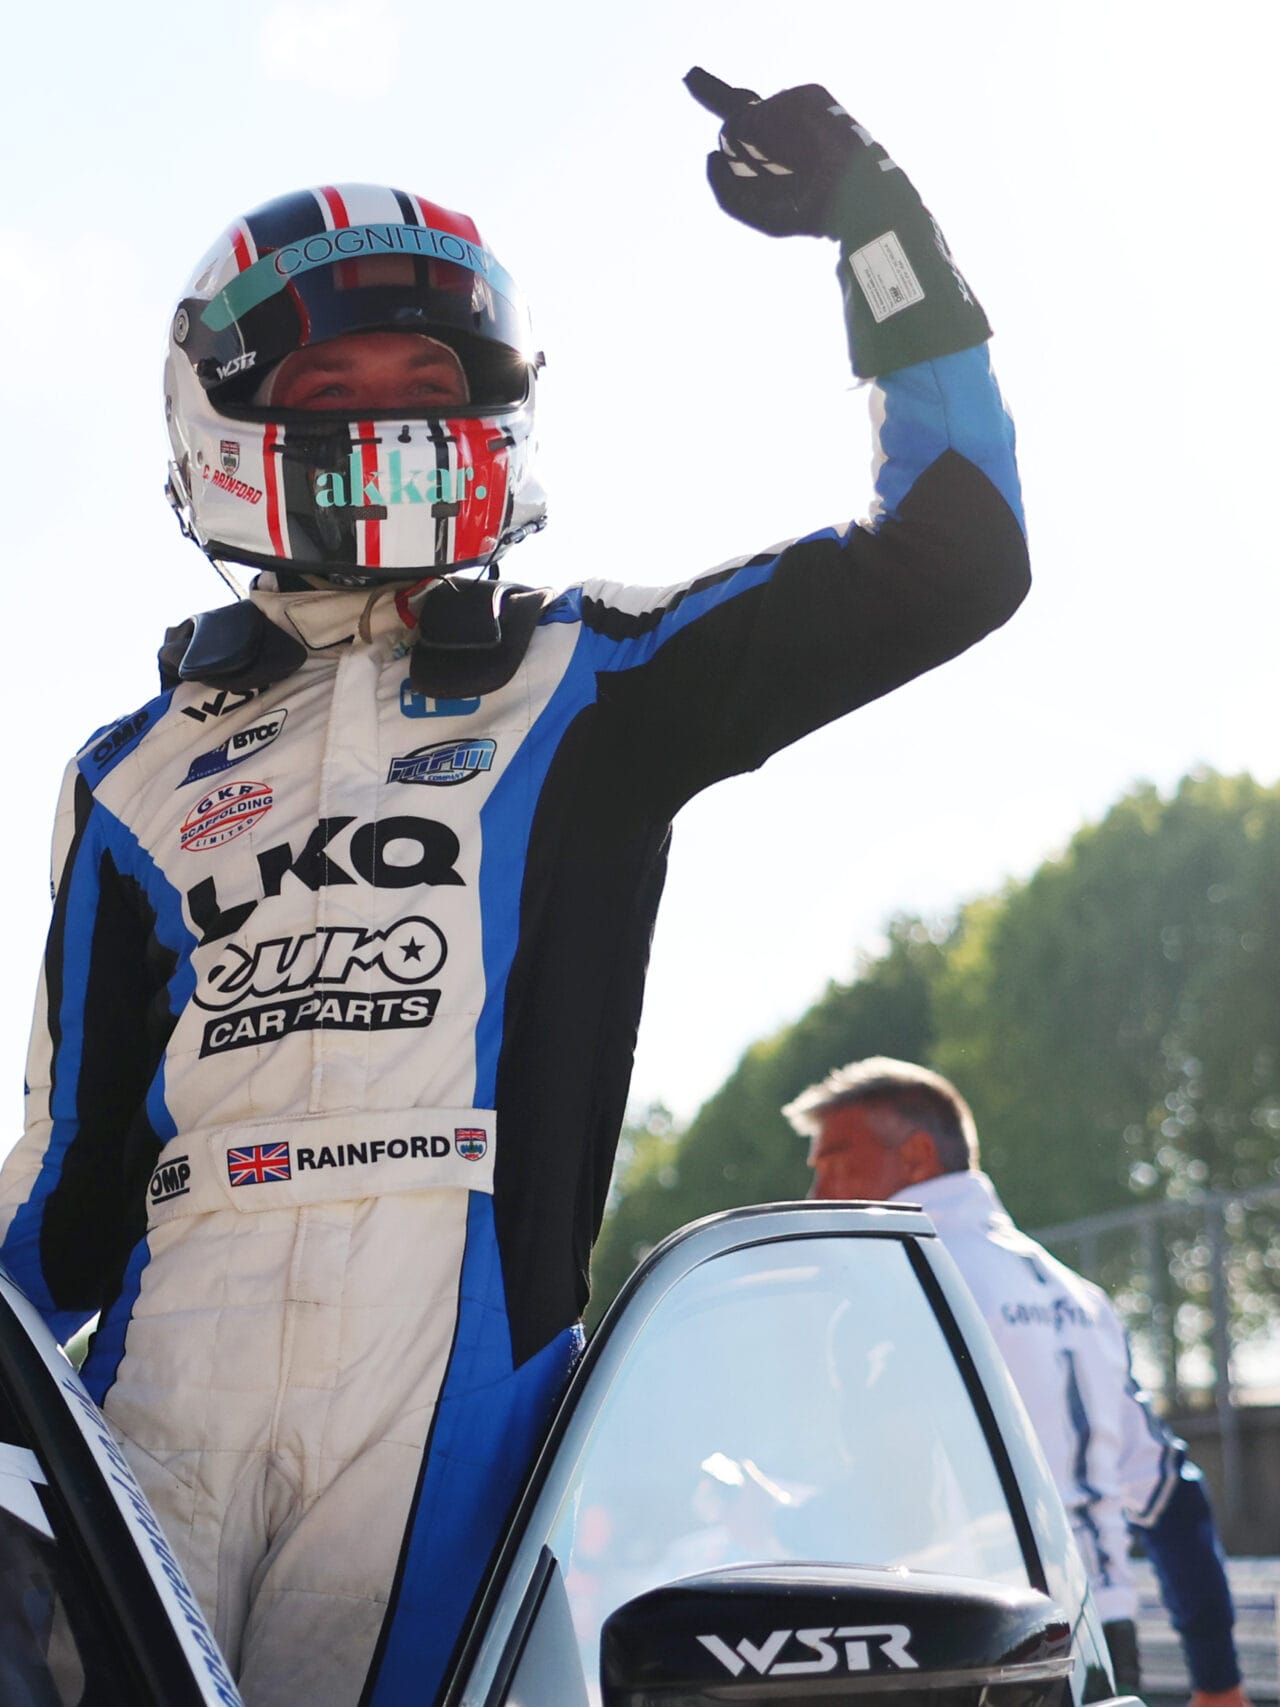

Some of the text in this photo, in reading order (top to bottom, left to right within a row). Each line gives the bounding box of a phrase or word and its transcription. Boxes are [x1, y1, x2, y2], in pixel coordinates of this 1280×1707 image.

[274, 226, 488, 276] COGNITION
[211, 469, 263, 505] RAINFORD
[315, 450, 487, 508] akkar.
[93, 711, 149, 762] OMP
[233, 722, 279, 750] BTCC
[180, 796, 273, 843] SCAFFOLDING
[196, 818, 253, 847] LIMITED
[187, 816, 466, 947] LKQ
[209, 996, 430, 1047] CAR PARTS
[150, 1136, 451, 1197] OMP RAINFORD
[695, 1624, 919, 1678] WSR
